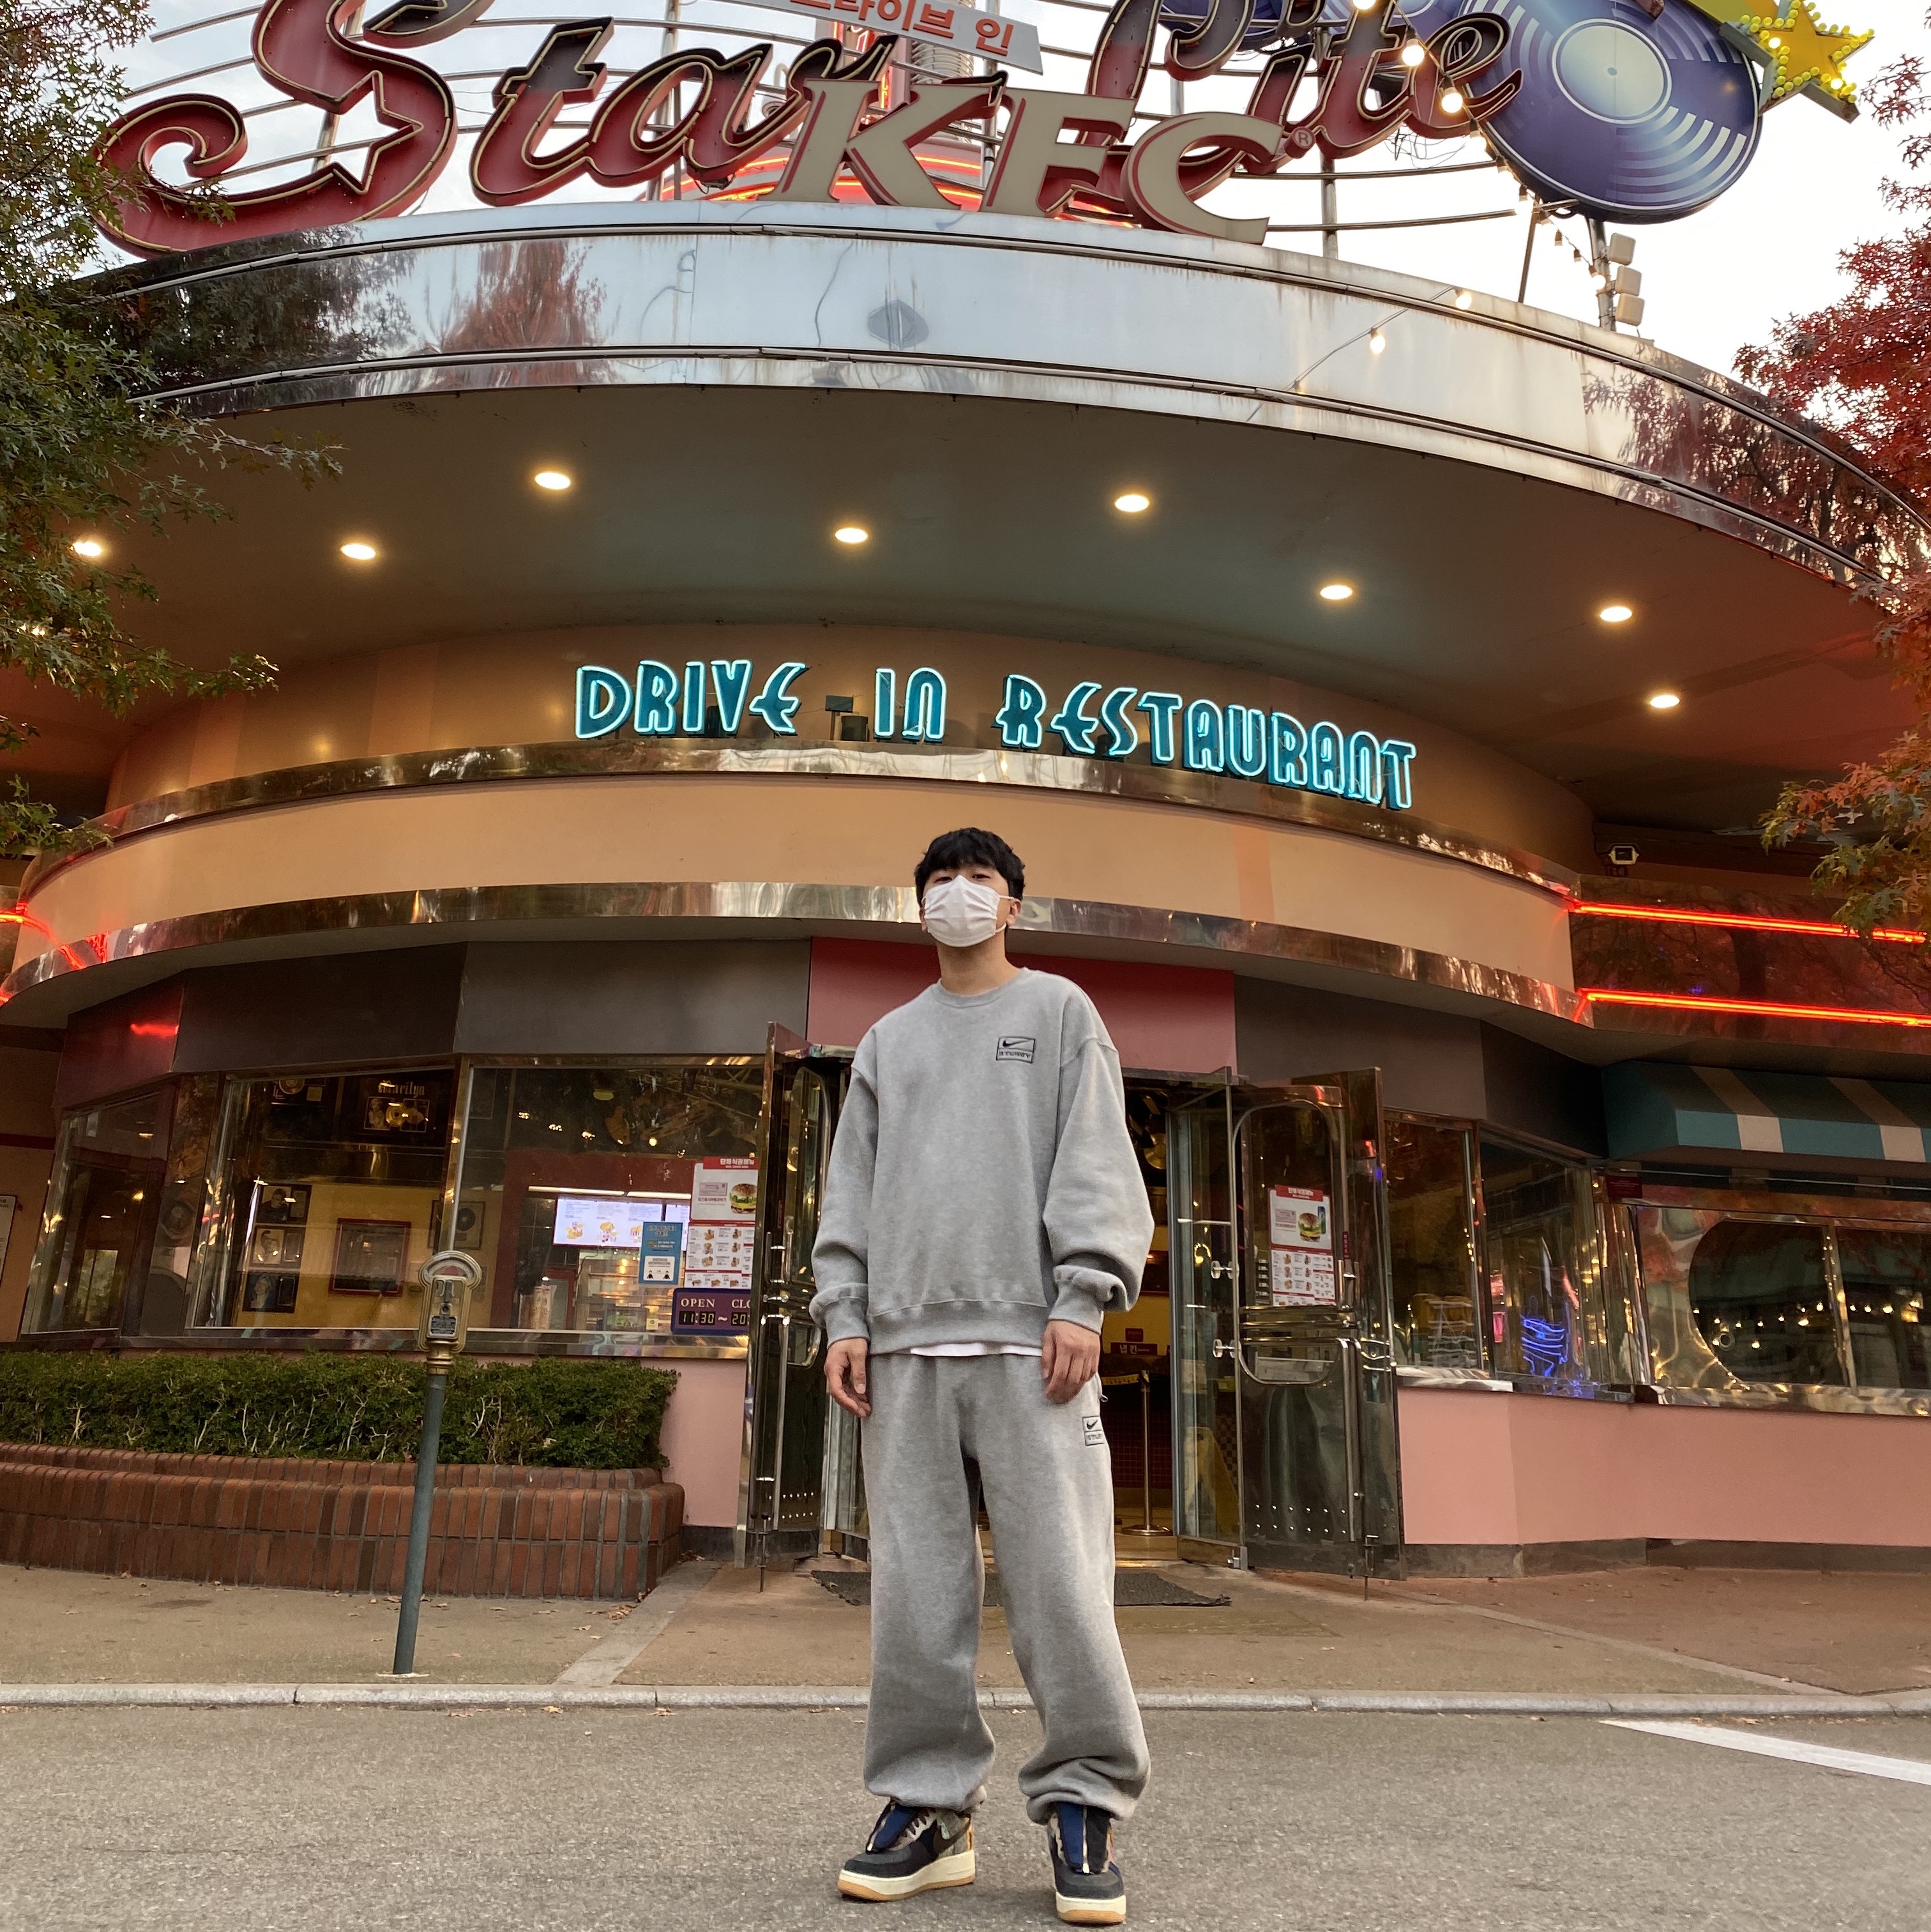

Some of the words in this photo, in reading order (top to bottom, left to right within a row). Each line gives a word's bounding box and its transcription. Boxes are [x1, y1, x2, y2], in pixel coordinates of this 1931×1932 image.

[791, 0, 955, 39] 이브
[975, 18, 1014, 56] 인
[757, 77, 1285, 245] KFC
[575, 659, 811, 739] DRIVE
[873, 667, 948, 742] IN
[993, 674, 1416, 810] RESTAURANT
[680, 1298, 716, 1308] OPEN
[683, 1312, 715, 1324] 11:30
